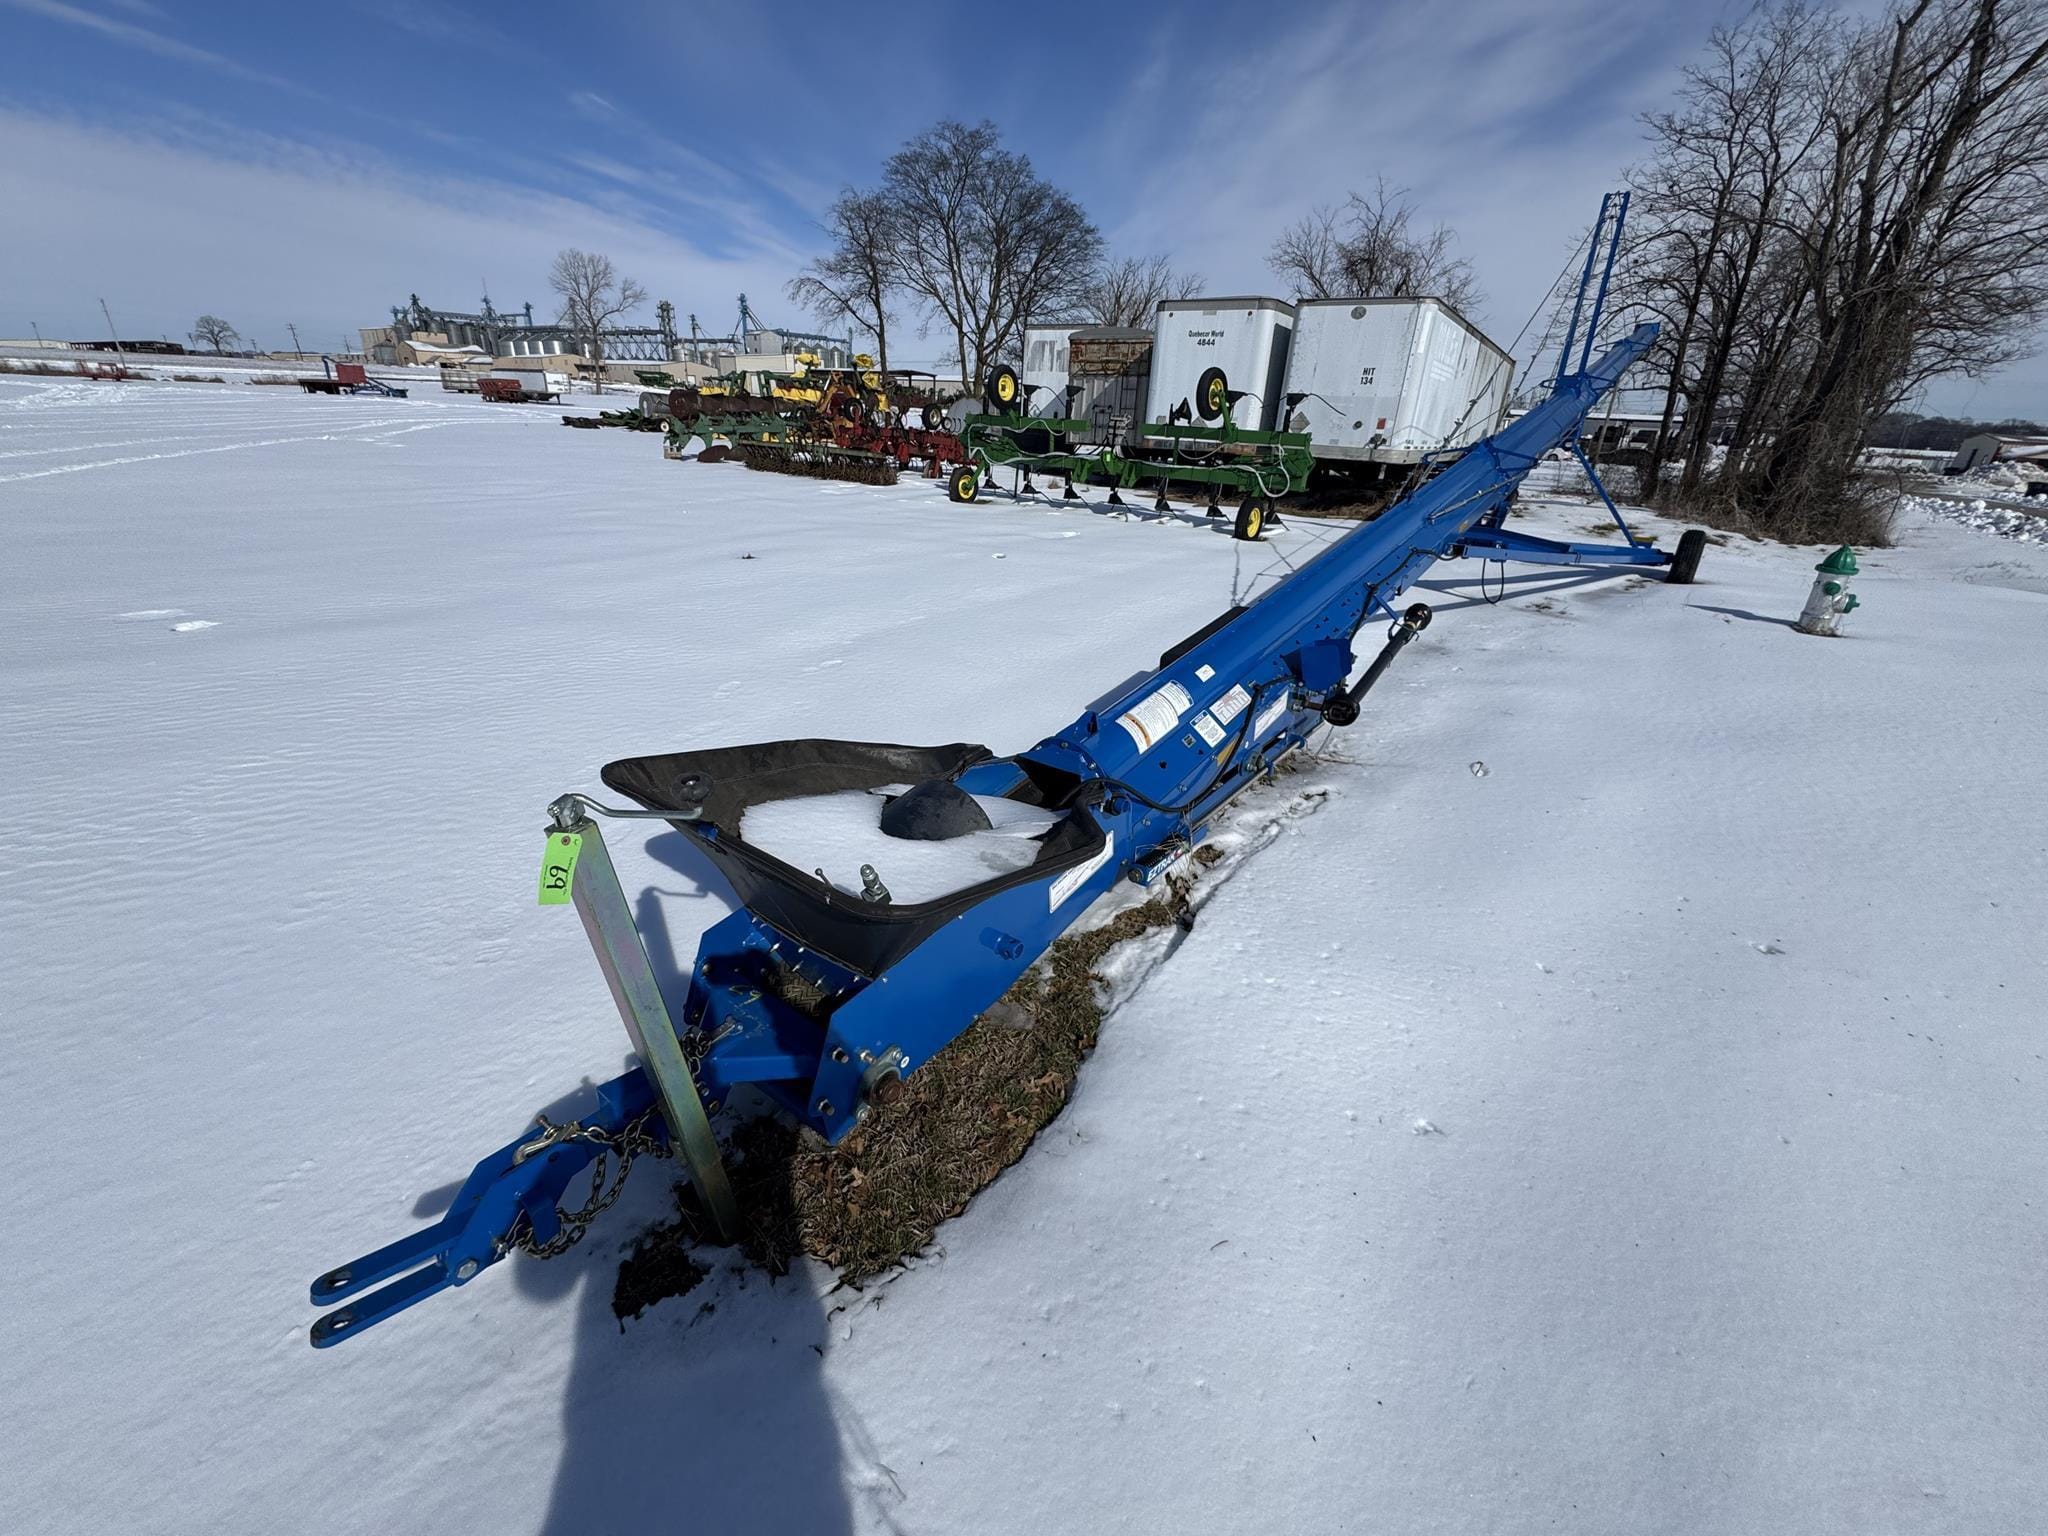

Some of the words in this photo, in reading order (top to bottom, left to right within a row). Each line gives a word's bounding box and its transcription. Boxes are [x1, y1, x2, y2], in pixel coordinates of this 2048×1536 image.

[1197, 338, 1215, 346] 4844
[1362, 367, 1376, 376] HIT
[1360, 376, 1373, 385] 134
[546, 865, 568, 889] 69
